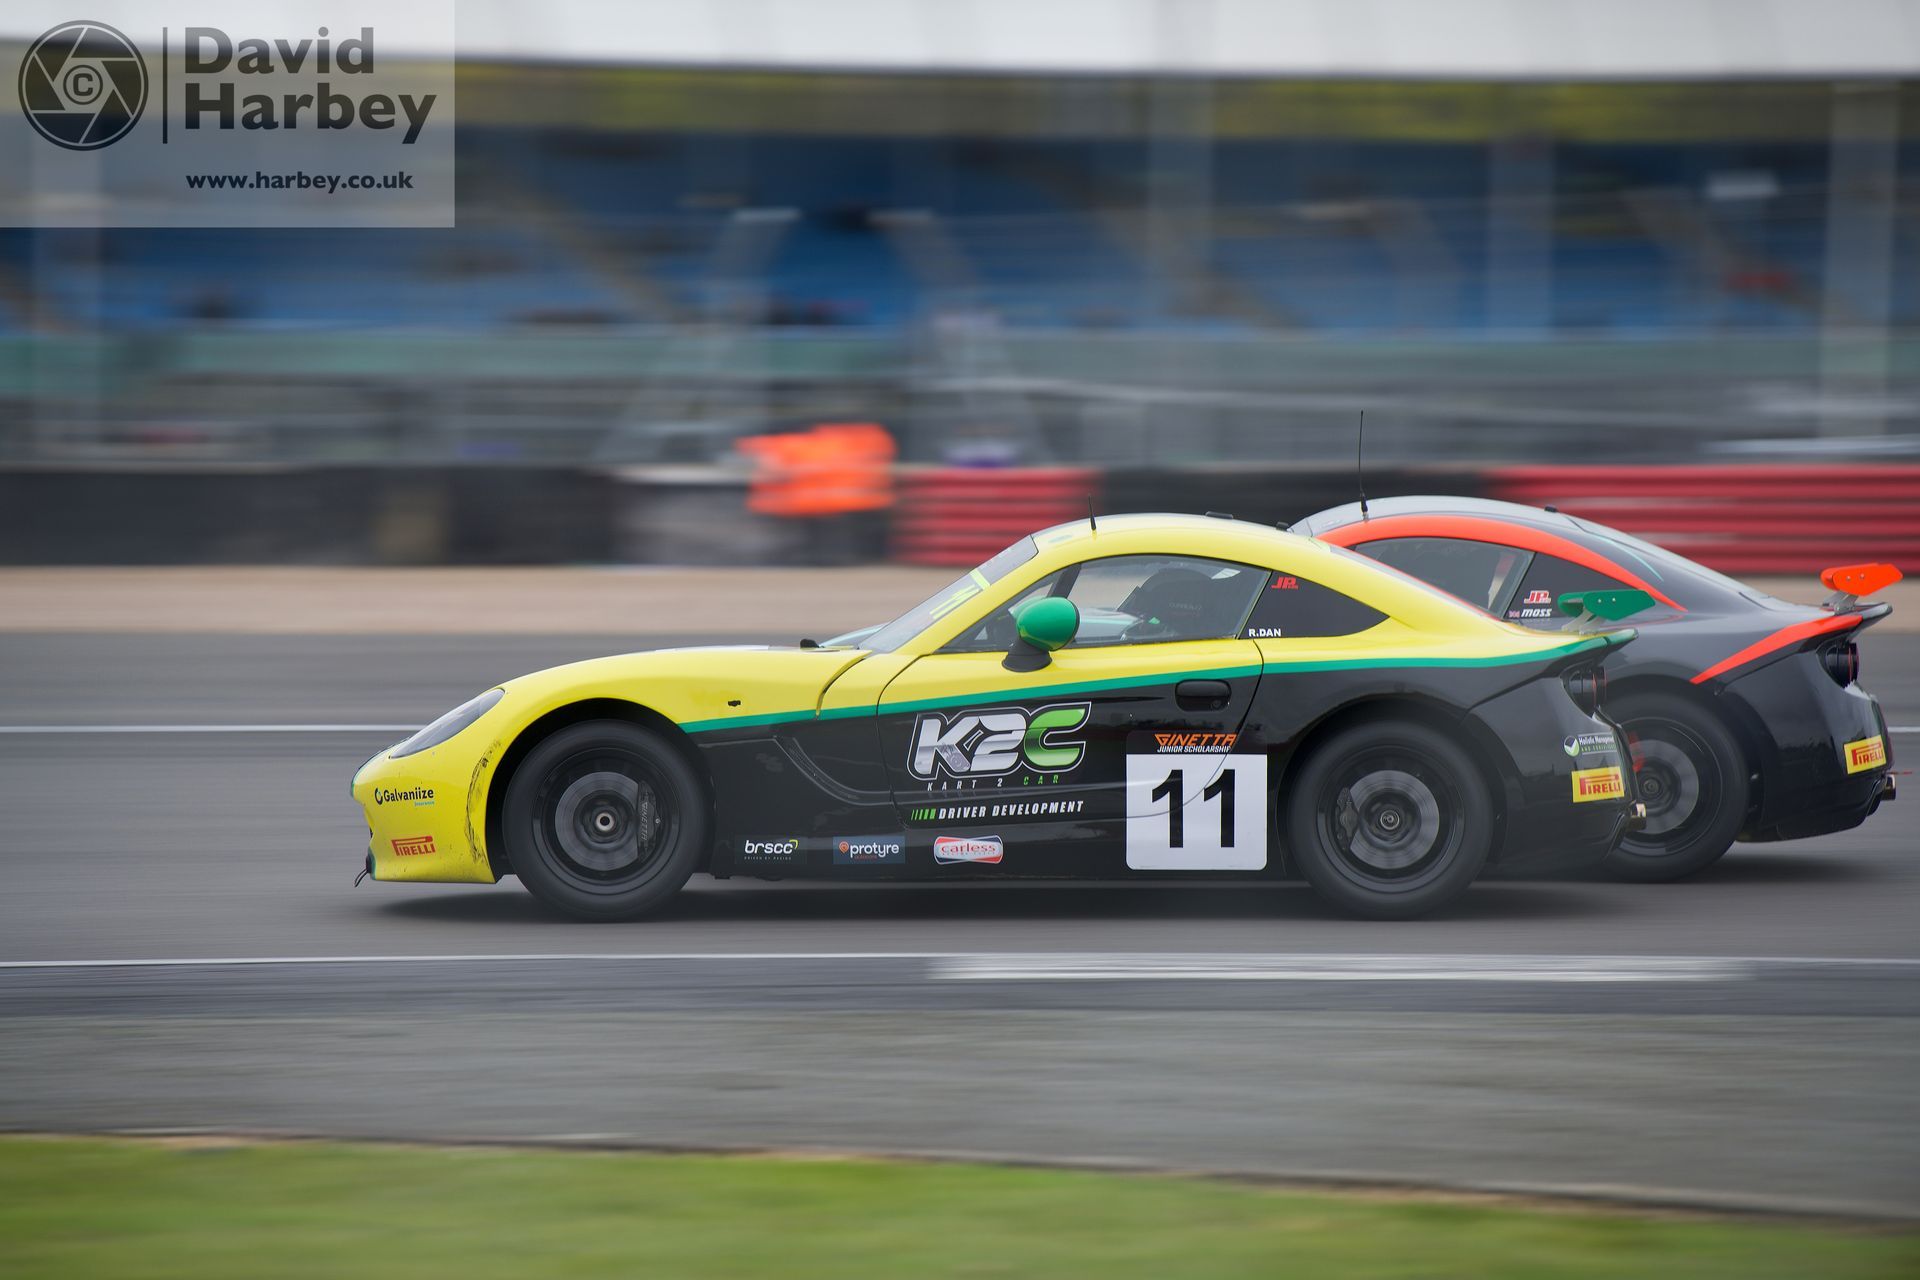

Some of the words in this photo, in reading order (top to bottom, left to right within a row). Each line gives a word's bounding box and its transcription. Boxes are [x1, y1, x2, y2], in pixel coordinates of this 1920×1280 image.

[1248, 628, 1281, 637] R.DAN
[909, 704, 1090, 778] K2C
[1155, 733, 1238, 746] GINETTA
[1157, 745, 1183, 753] JUNIOR
[927, 780, 977, 791] KART
[997, 778, 1003, 787] 2
[1023, 775, 1059, 785] CAR
[1579, 773, 1621, 795] PIRELLI
[383, 787, 434, 803] Galvaniize
[938, 806, 986, 820] DRIVER
[991, 801, 1084, 818] DEVELOPMENT
[1152, 769, 1236, 848] 11
[391, 835, 436, 856] PIRELLI
[744, 839, 794, 854] brscc
[850, 841, 899, 858] protyre
[941, 842, 995, 853] carless
